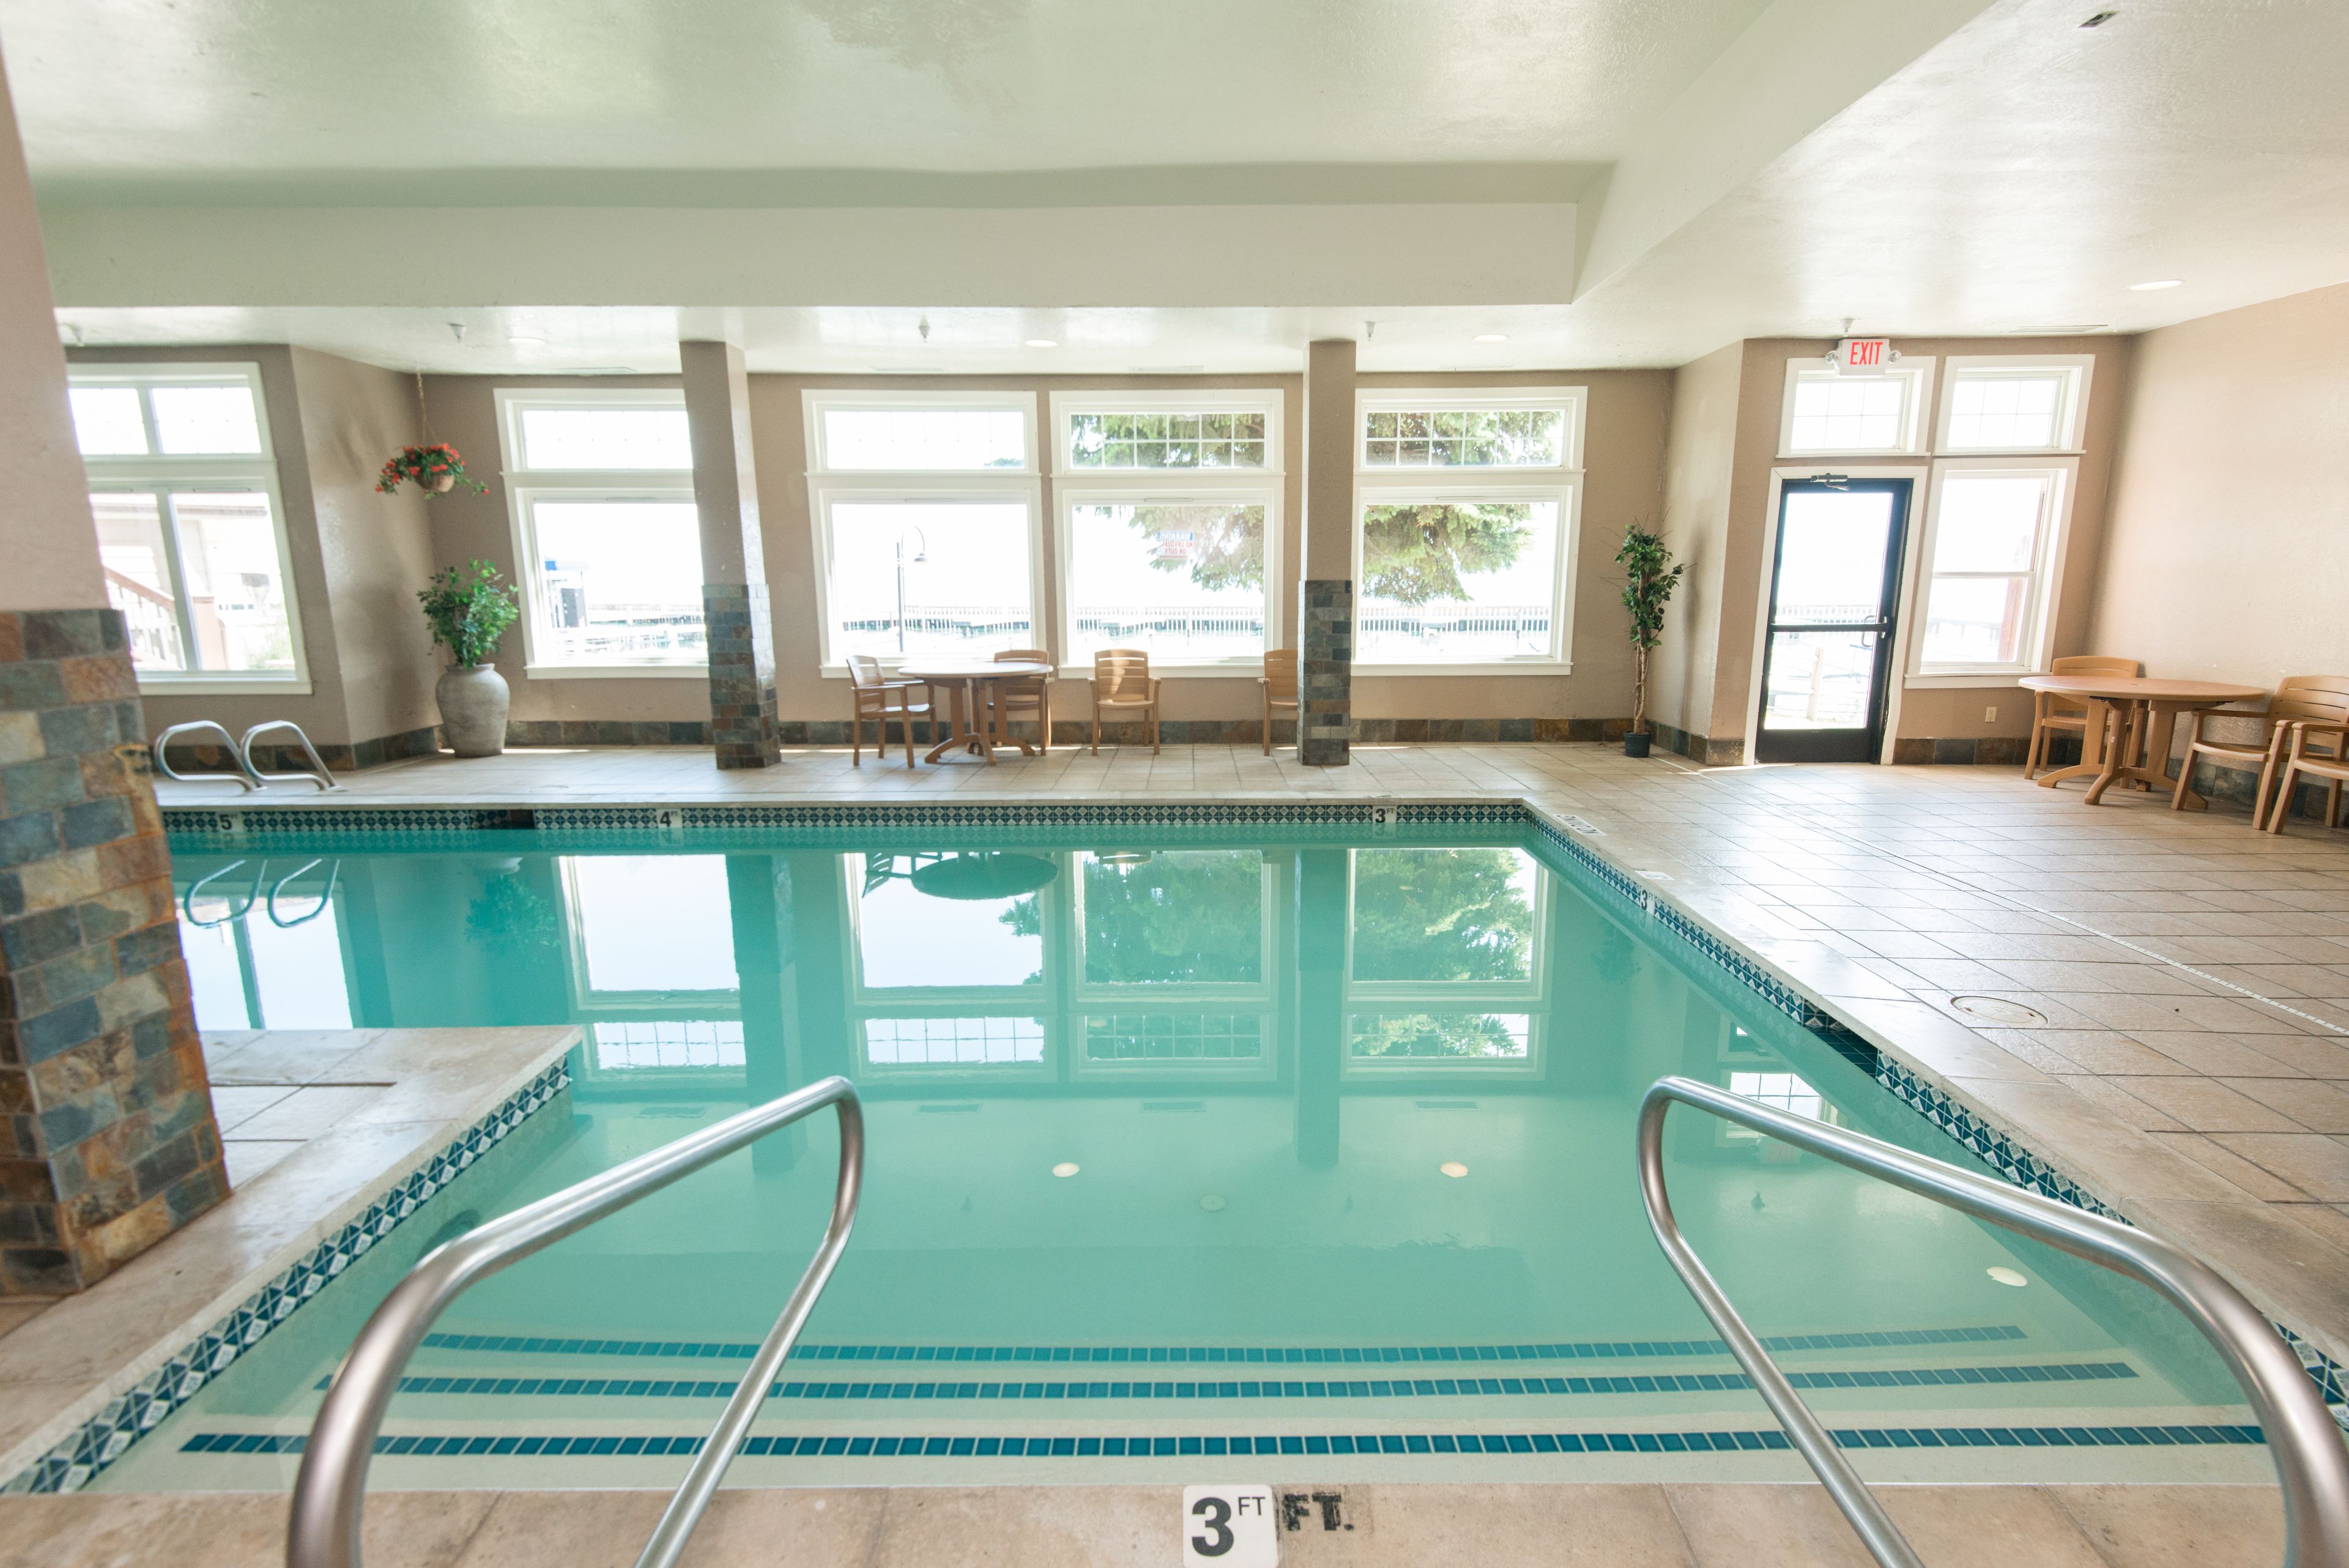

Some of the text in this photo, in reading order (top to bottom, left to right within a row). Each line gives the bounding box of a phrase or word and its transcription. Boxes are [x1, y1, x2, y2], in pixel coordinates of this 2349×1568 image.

[1850, 342, 1883, 365] EXIT
[220, 814, 231, 830] 5
[660, 811, 672, 827] 4
[1375, 808, 1386, 823] 3
[1641, 890, 1648, 910] 3
[1282, 1492, 1354, 1531] FT.
[1191, 1496, 1266, 1557] 3 FT
